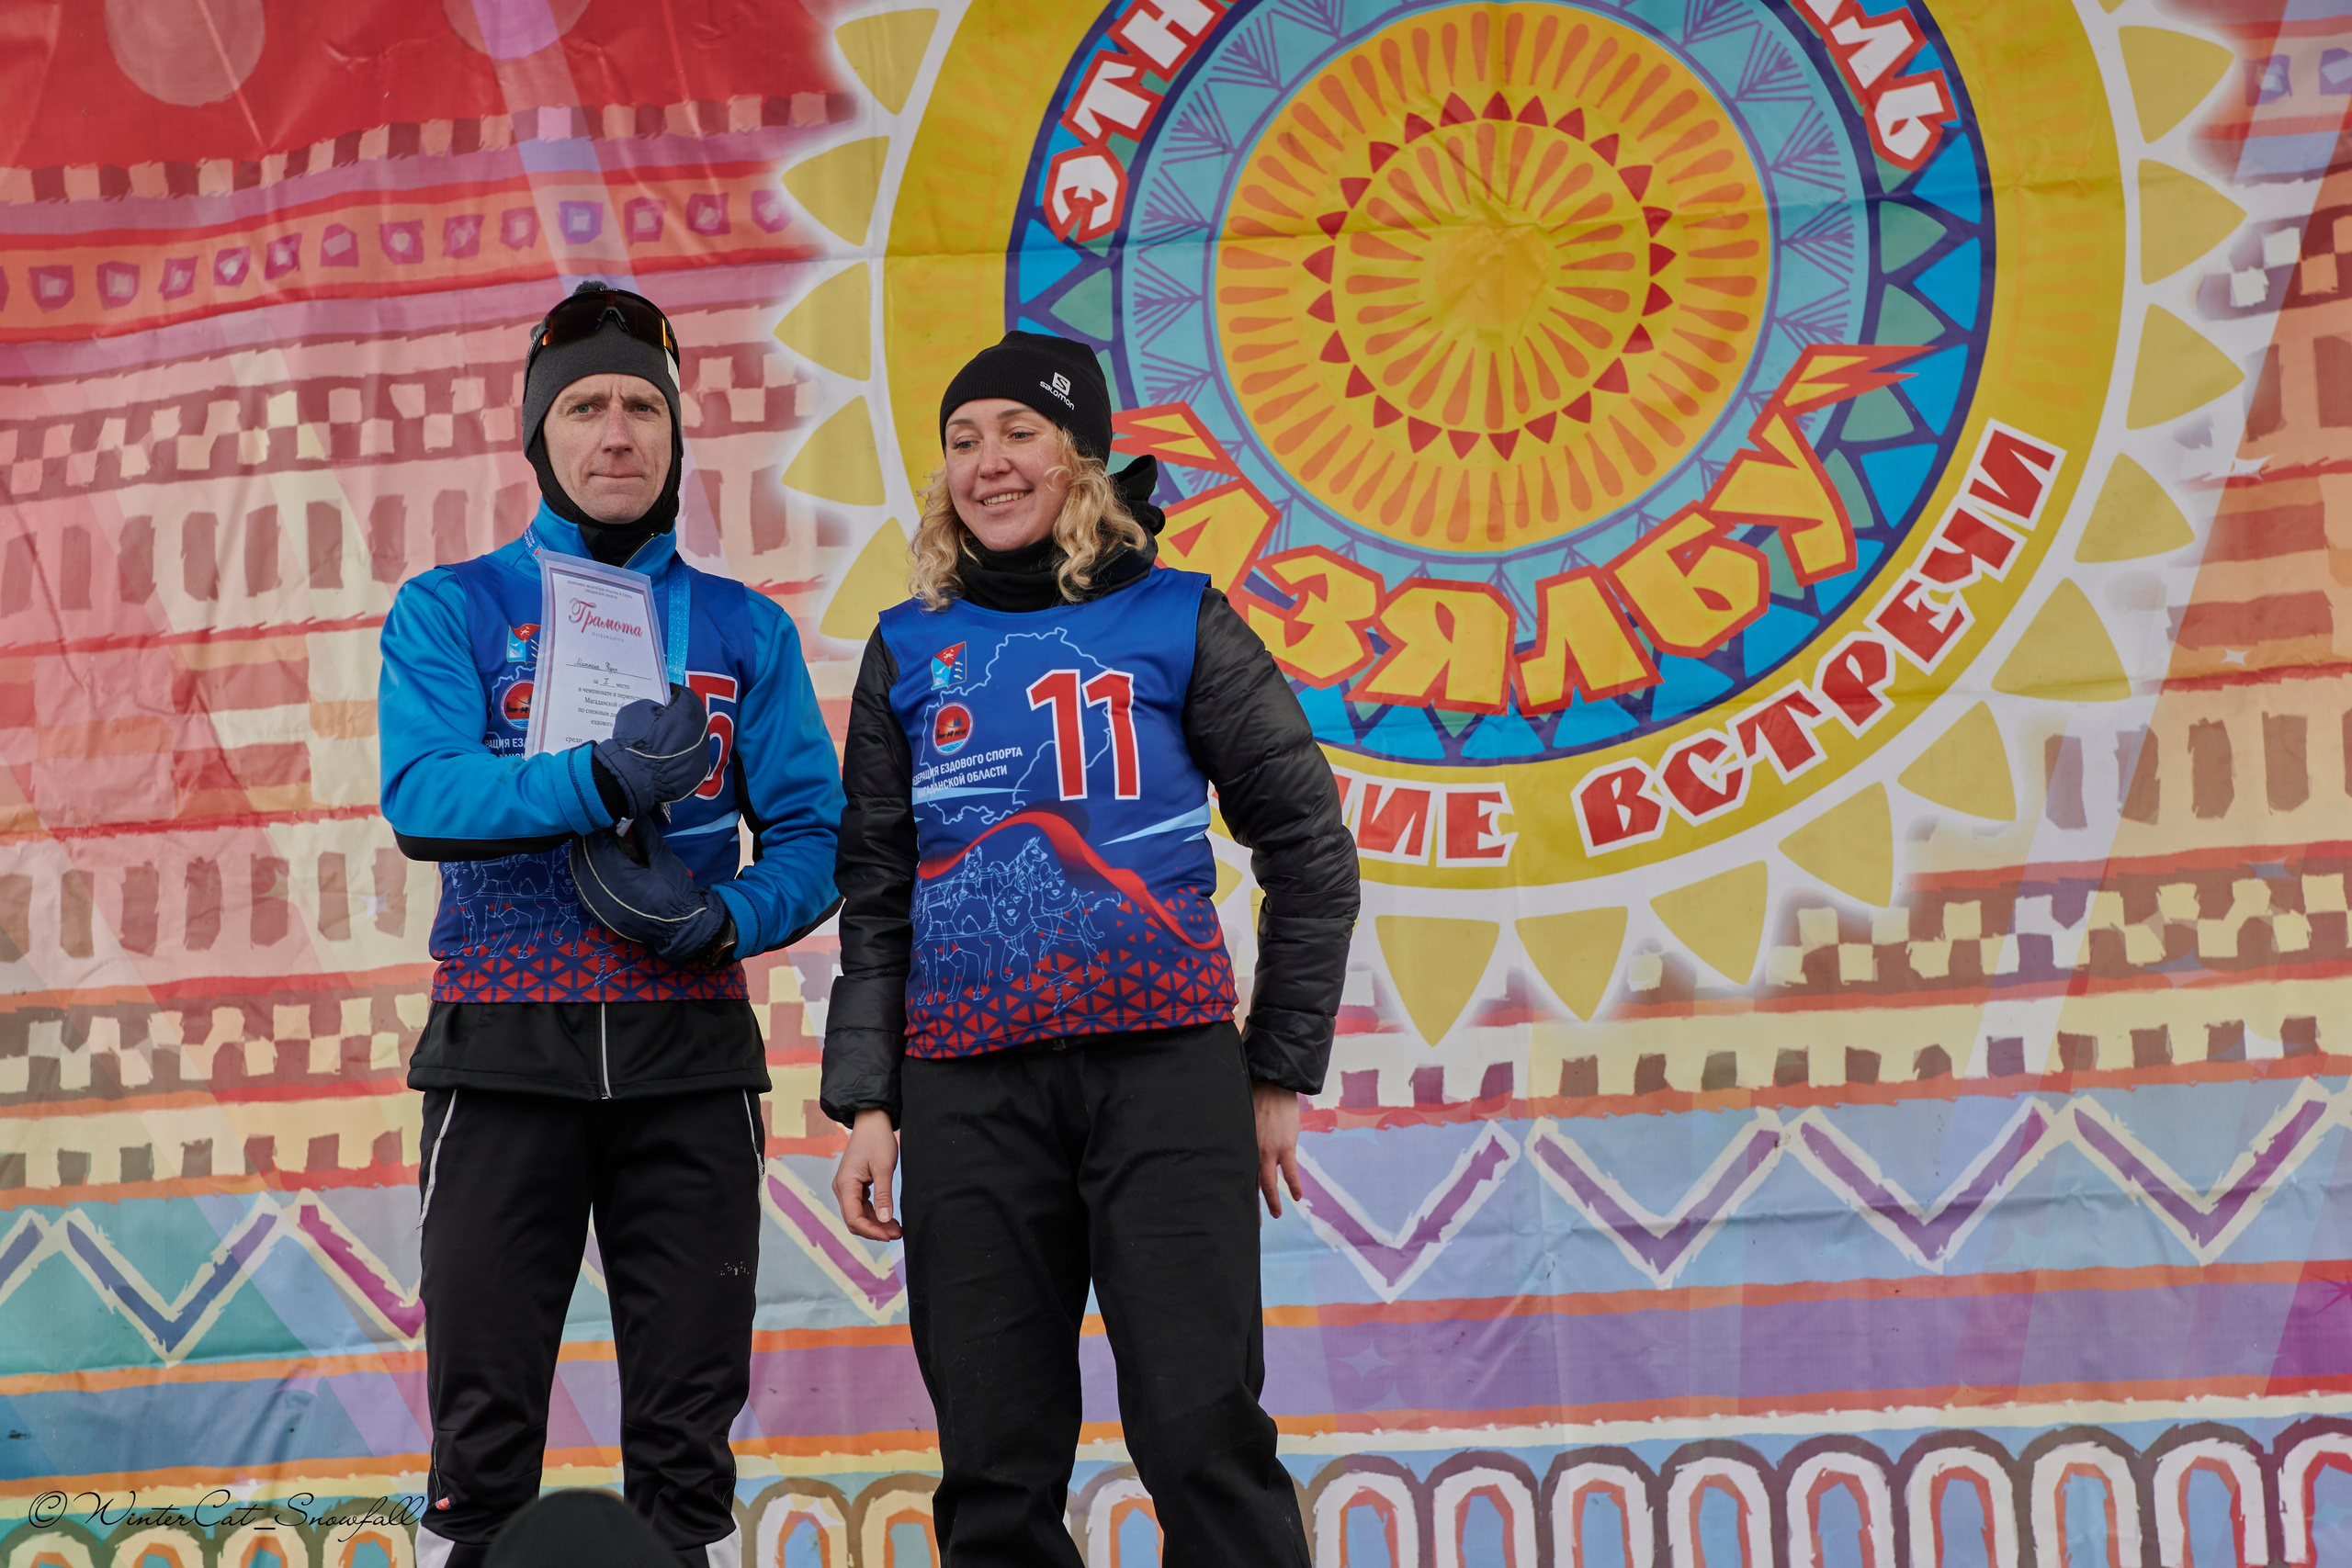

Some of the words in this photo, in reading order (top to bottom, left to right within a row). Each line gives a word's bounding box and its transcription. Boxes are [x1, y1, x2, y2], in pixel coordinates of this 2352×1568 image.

[1801, 0, 1954, 166] ЛЬ
[569, 598, 643, 637] Грамота
[1575, 423, 2062, 852] ВСТРЕЧИ
[582, 688, 612, 696] чемпионате
[584, 697, 618, 708] Магаданской
[585, 708, 609, 716] снежным
[591, 719, 614, 728] ездового
[565, 736, 582, 744] среди
[1025, 669, 1141, 801] 11
[940, 754, 985, 775] ЕЗДОВОГО
[985, 746, 1023, 762] СПОРТА
[967, 765, 1008, 784] ОБЛАСТИ
